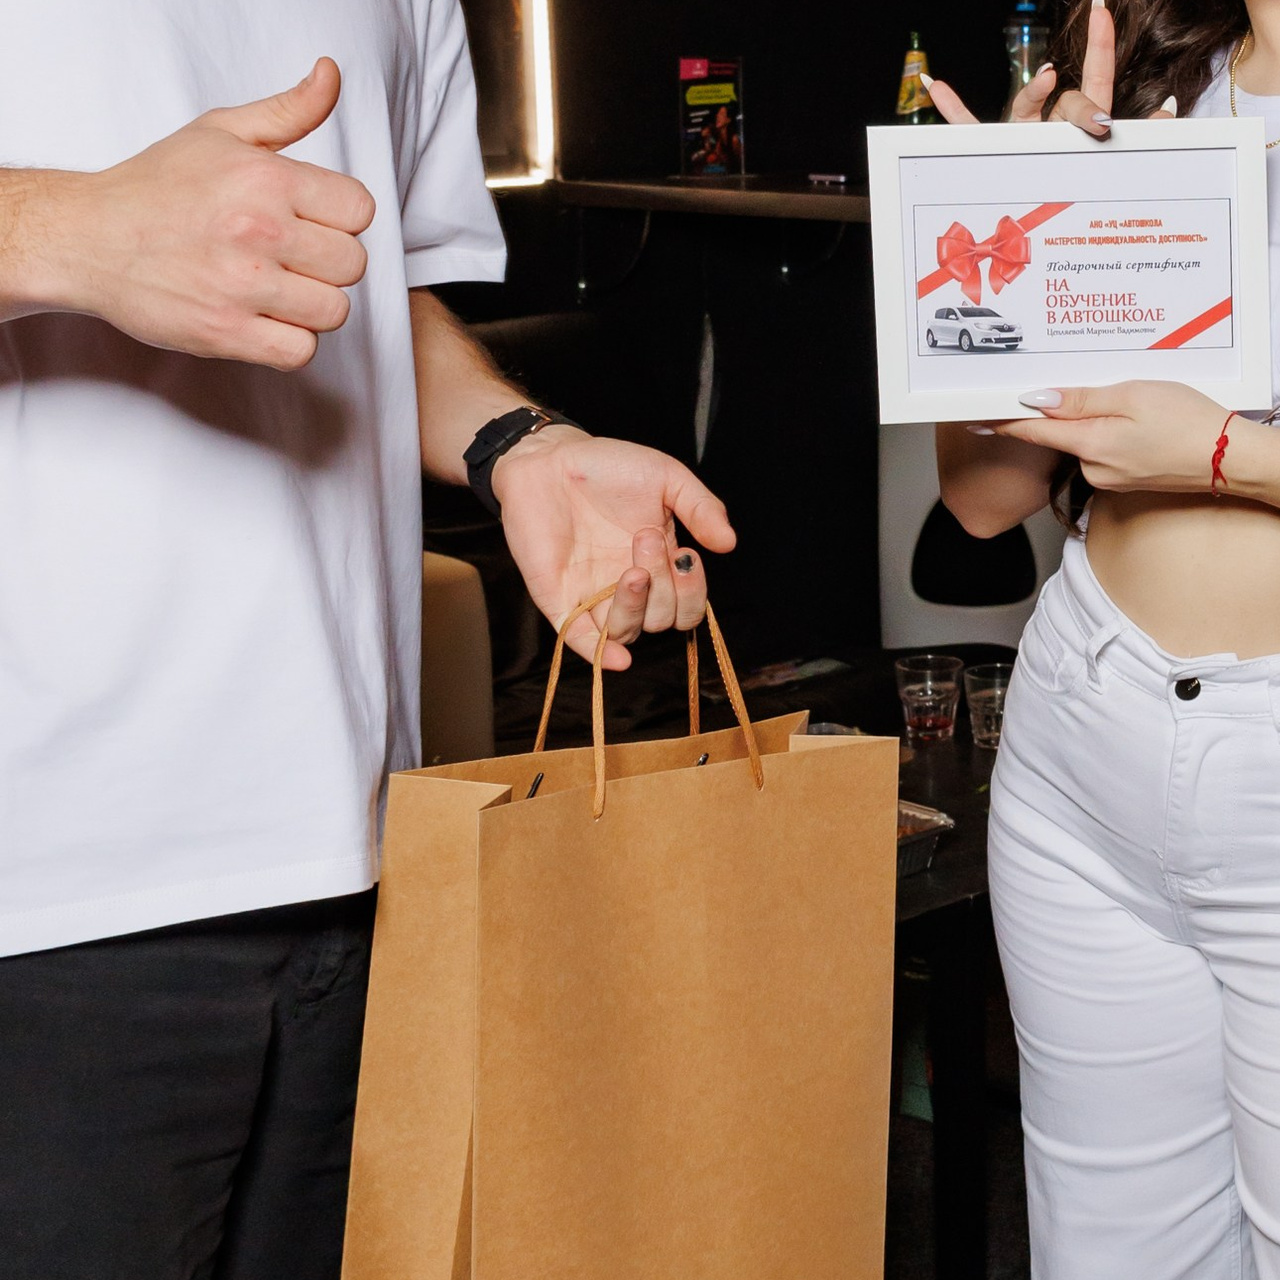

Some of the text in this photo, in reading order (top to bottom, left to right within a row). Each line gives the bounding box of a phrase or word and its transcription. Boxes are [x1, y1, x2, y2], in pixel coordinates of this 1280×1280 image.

[1089, 220, 1103, 228] АНО
[1119, 218, 1163, 229] «АВТОШКОЛА
[1044, 233, 1208, 246] МАСТЕРСТВО ИНДИВИДУАЛЬНОСТЬ ДОСТУПНОСТЬ»
[1046, 257, 1201, 274] Подарочный сертификат
[1045, 278, 1070, 292] НА
[1045, 293, 1137, 309] ОБУЧЕНИЕ
[1046, 308, 1166, 324] В АВТОШКОЛЕ
[1086, 327, 1116, 337] Марине
[1117, 326, 1156, 336] Вадимовне
